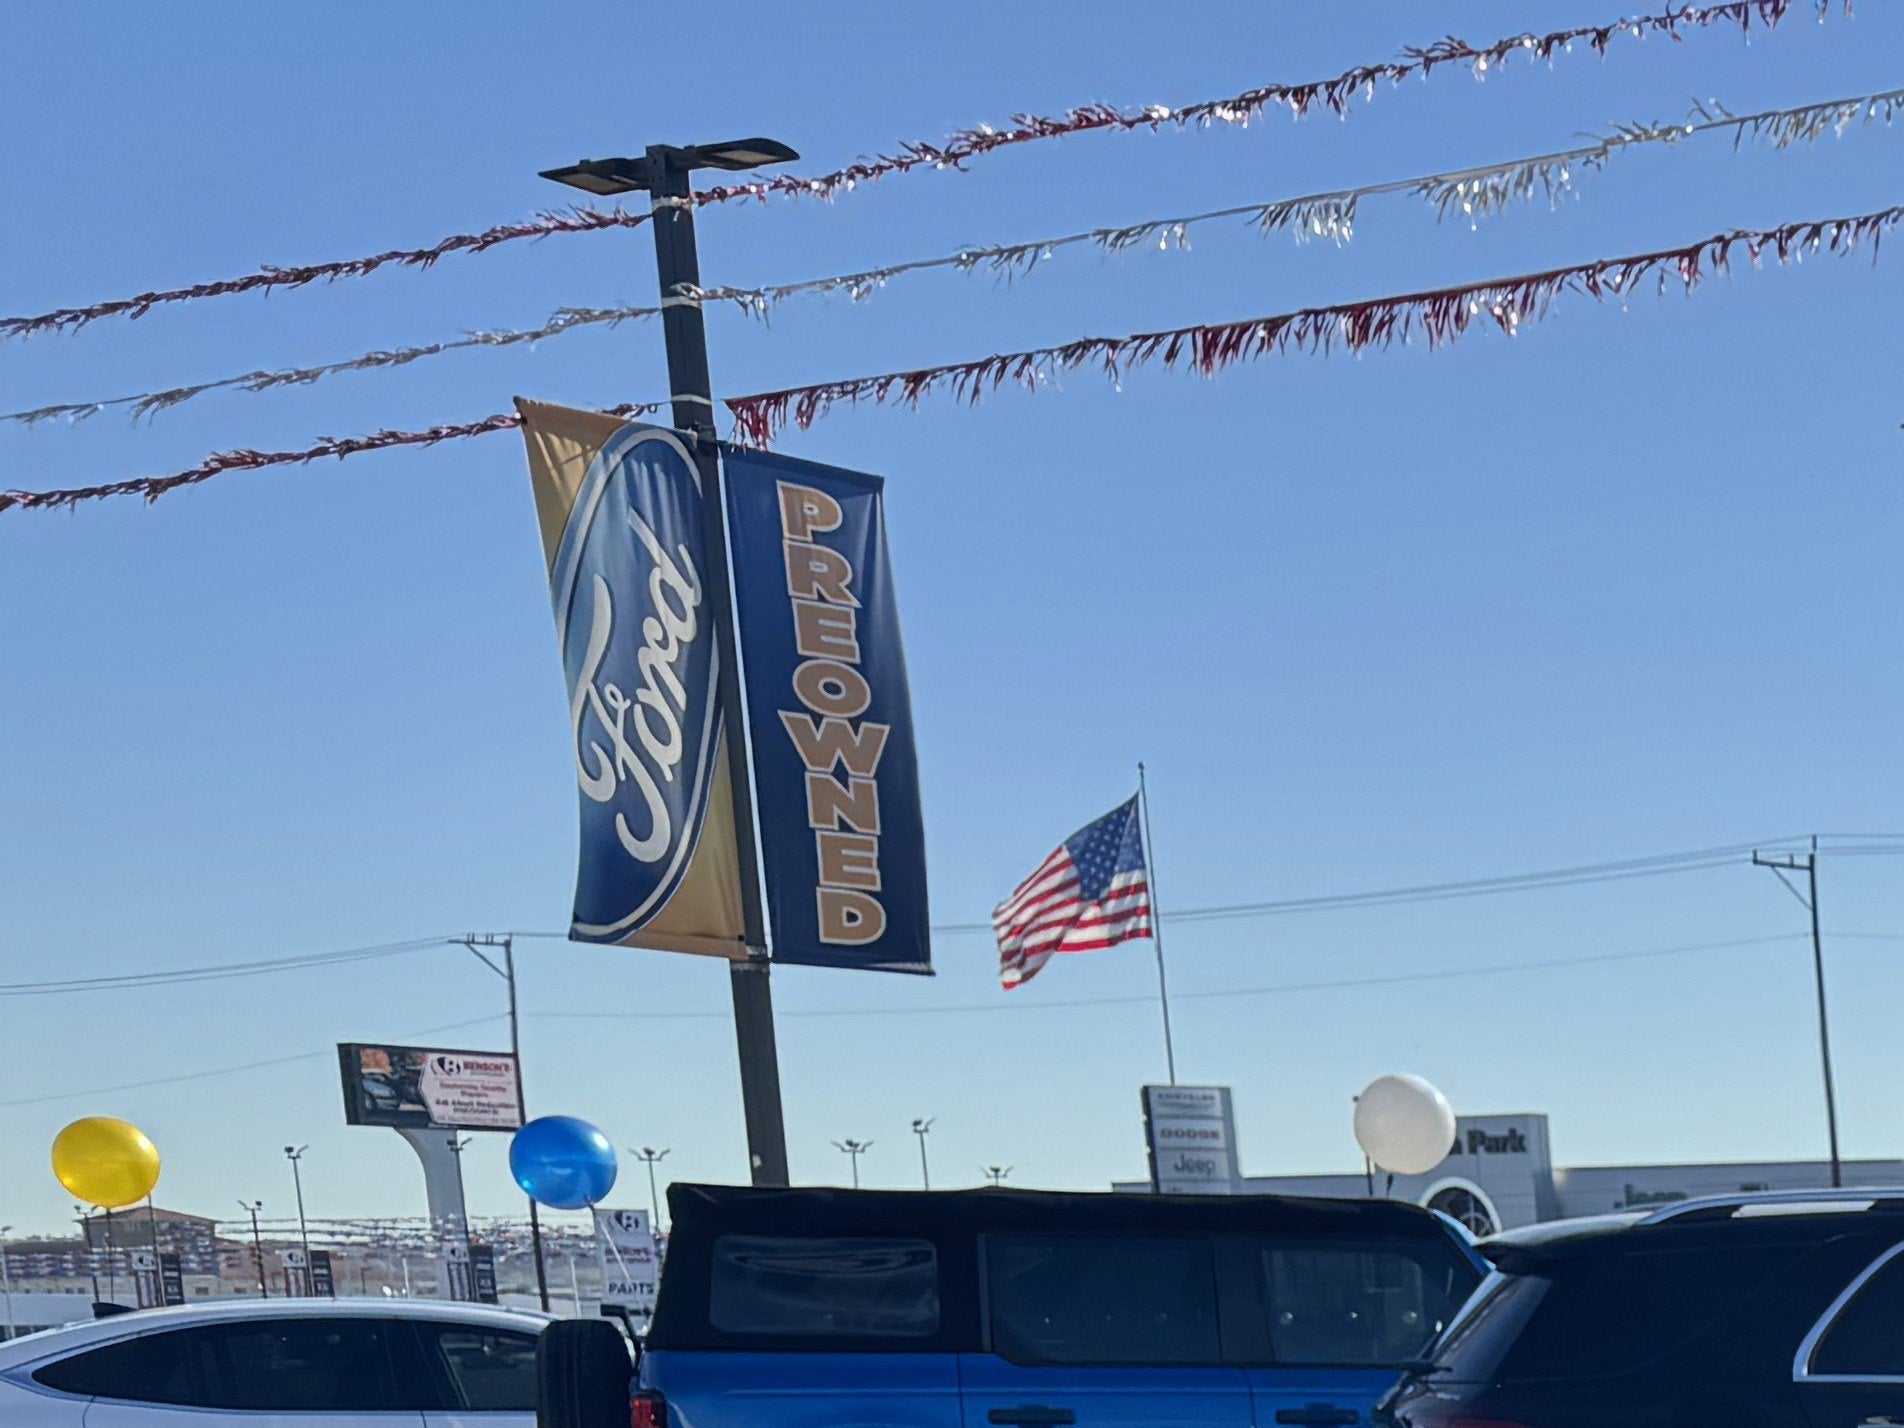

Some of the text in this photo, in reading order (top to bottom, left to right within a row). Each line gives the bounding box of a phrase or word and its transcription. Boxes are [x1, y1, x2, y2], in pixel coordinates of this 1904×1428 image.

[572, 505, 702, 863] Ford
[776, 479, 891, 945] PREOWNED
[1173, 1152, 1216, 1177] Jeep
[1467, 1128, 1526, 1154] Park
